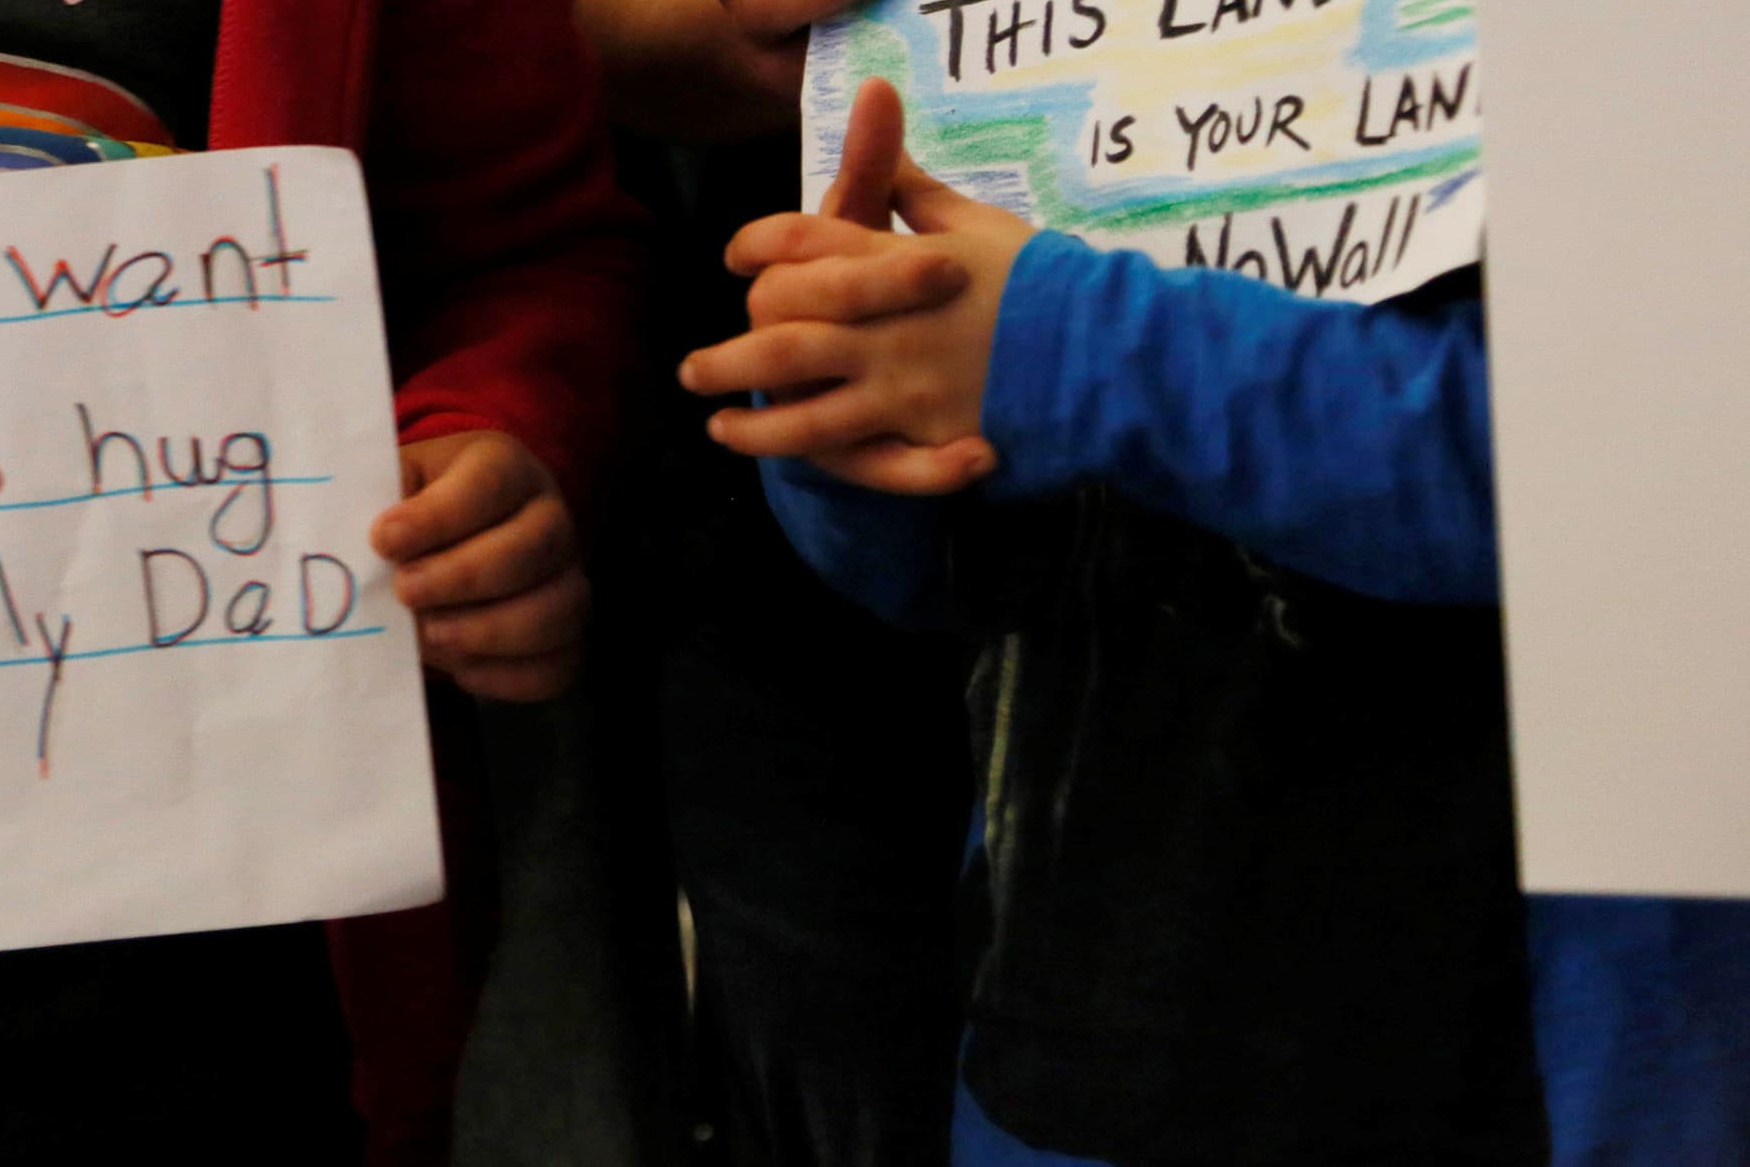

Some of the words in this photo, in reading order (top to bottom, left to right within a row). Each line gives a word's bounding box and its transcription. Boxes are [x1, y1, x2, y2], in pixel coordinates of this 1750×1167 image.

[1090, 115, 1136, 168] IS
[1174, 94, 1312, 172] YOUR
[1354, 62, 1483, 146] LAN
[5, 163, 310, 317] want
[76, 403, 277, 556] hug
[139, 548, 359, 648] DaD
